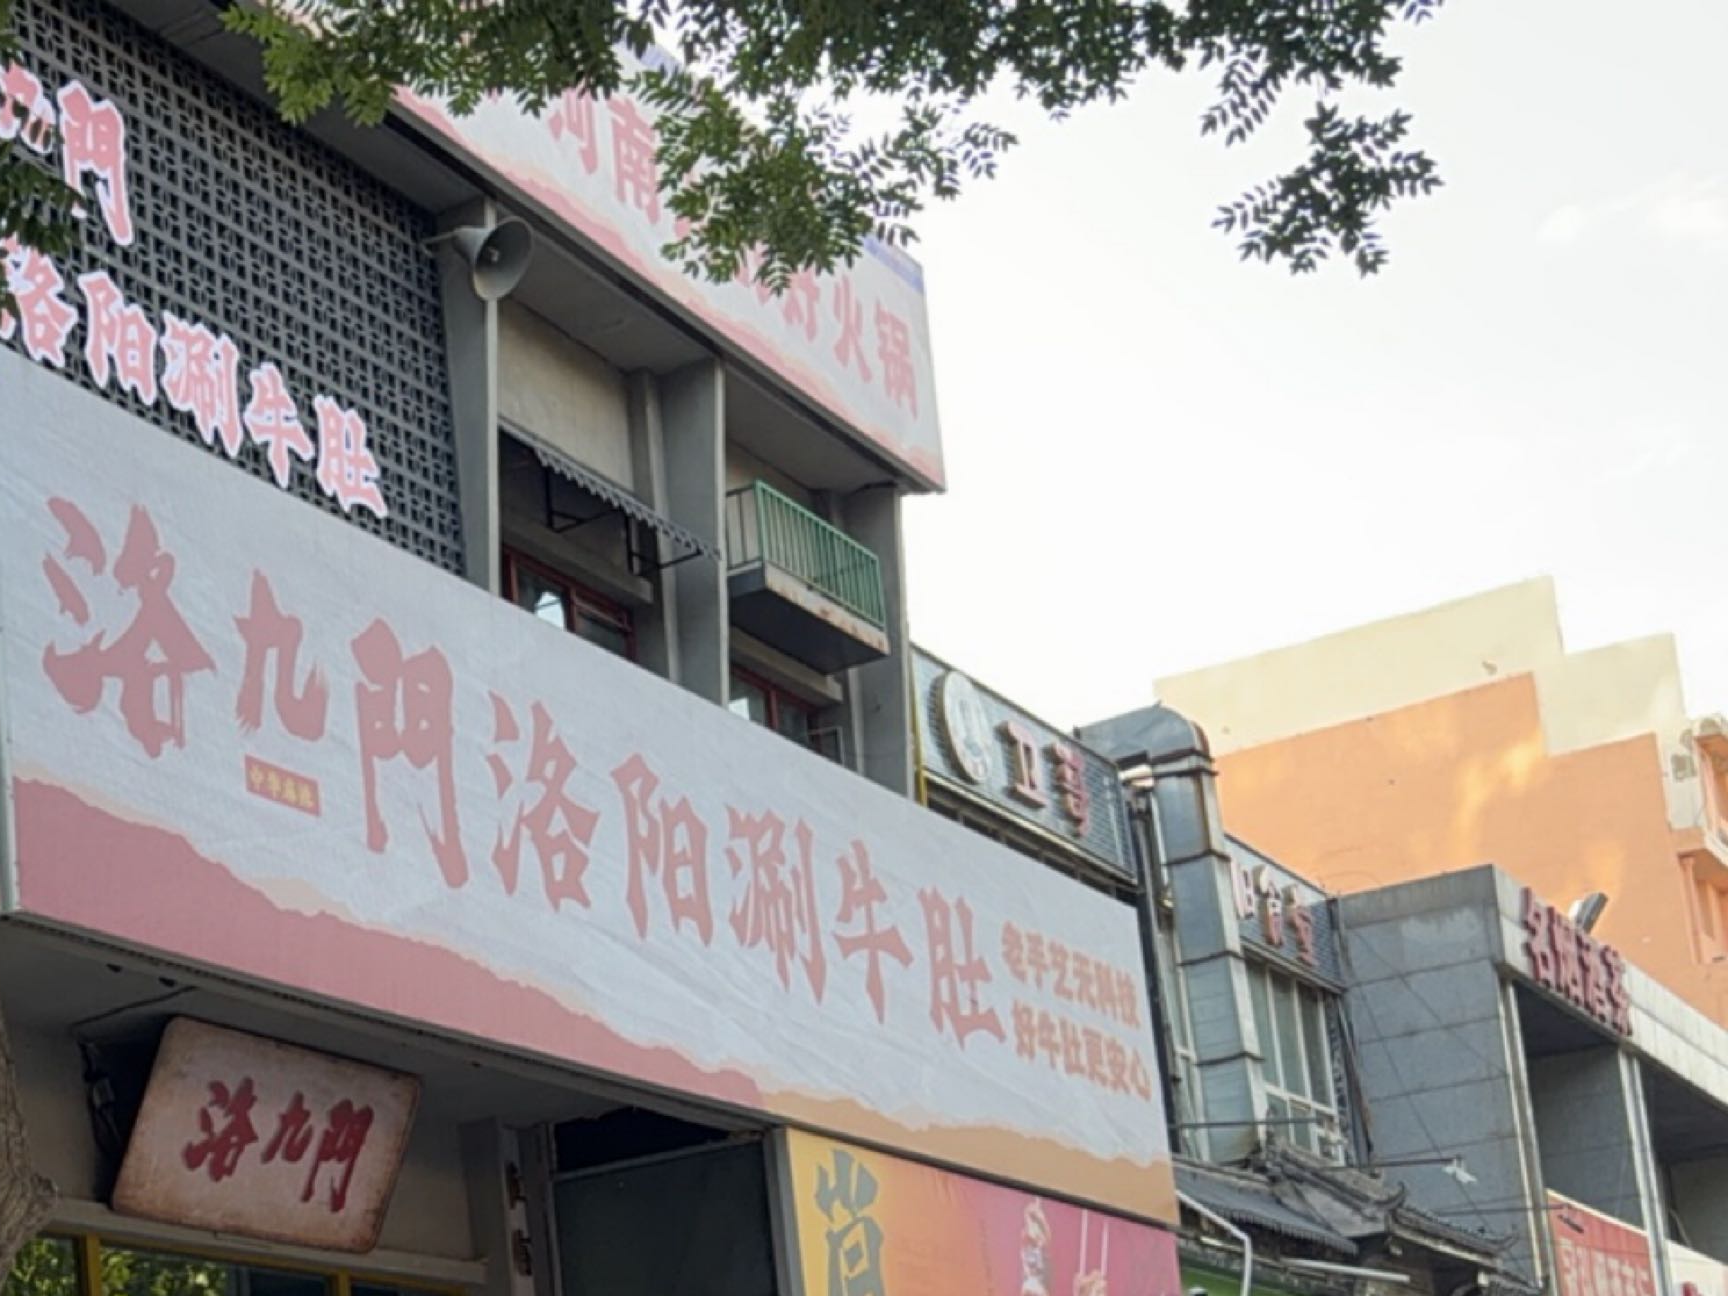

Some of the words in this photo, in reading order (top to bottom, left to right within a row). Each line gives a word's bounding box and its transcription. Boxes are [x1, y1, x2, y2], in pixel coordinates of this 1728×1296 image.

[1001, 920, 1140, 1030] 老手艺无科技
[1012, 997, 1152, 1102] 好牛肚更安心
[181, 1076, 374, 1213] 洛九門
